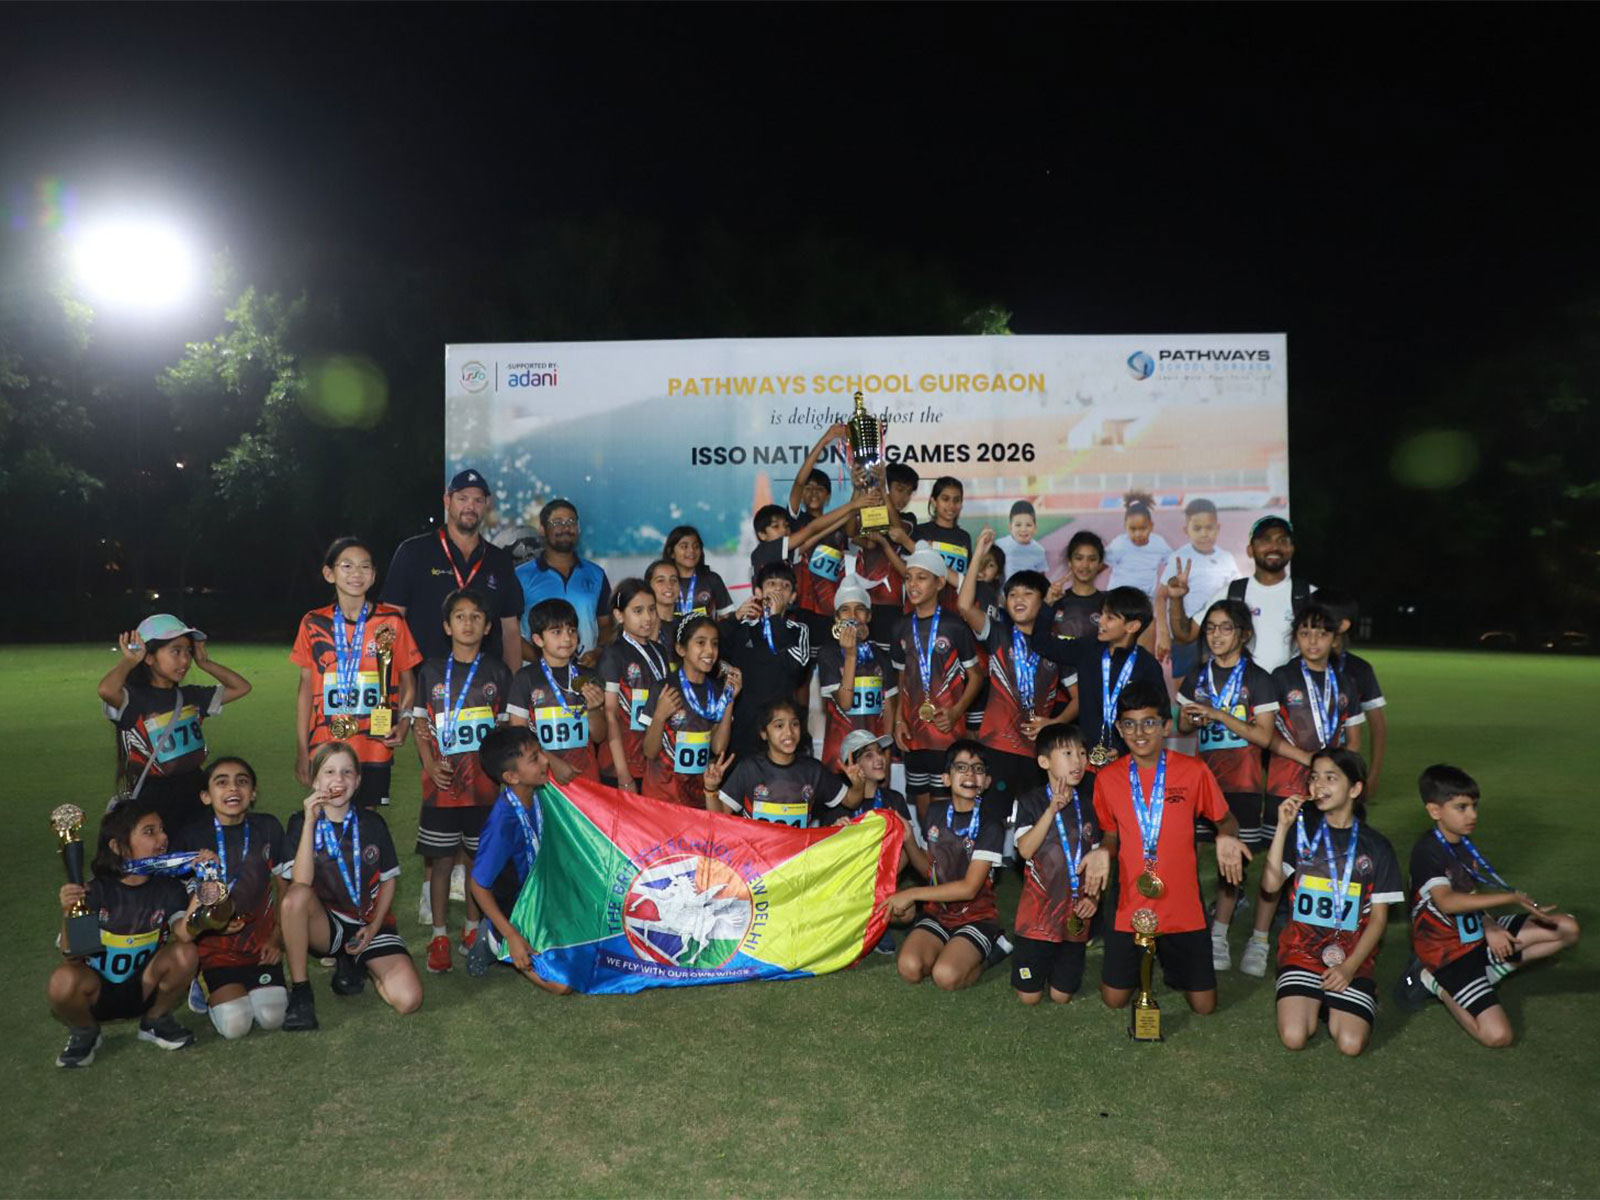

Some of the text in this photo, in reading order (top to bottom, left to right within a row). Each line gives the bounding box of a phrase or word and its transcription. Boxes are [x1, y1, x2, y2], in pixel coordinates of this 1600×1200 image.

[1159, 349, 1271, 361] PATHWAYS
[508, 369, 558, 388] adani
[667, 372, 1046, 397] PATHWAYS SCHOOL GURGAON
[770, 409, 782, 425] is
[919, 405, 944, 423] the
[691, 442, 1036, 466] ISSO NATION GAMES 2026
[156, 720, 203, 753] 078
[441, 723, 491, 748] 090
[540, 722, 583, 744] 091
[678, 747, 709, 768] 08
[1297, 892, 1354, 922] 087
[607, 900, 622, 935] THE
[743, 900, 769, 951] DELHI
[606, 955, 622, 968] WE
[622, 961, 640, 972] FLY
[640, 963, 666, 977] WITH
[667, 968, 690, 978] OUR
